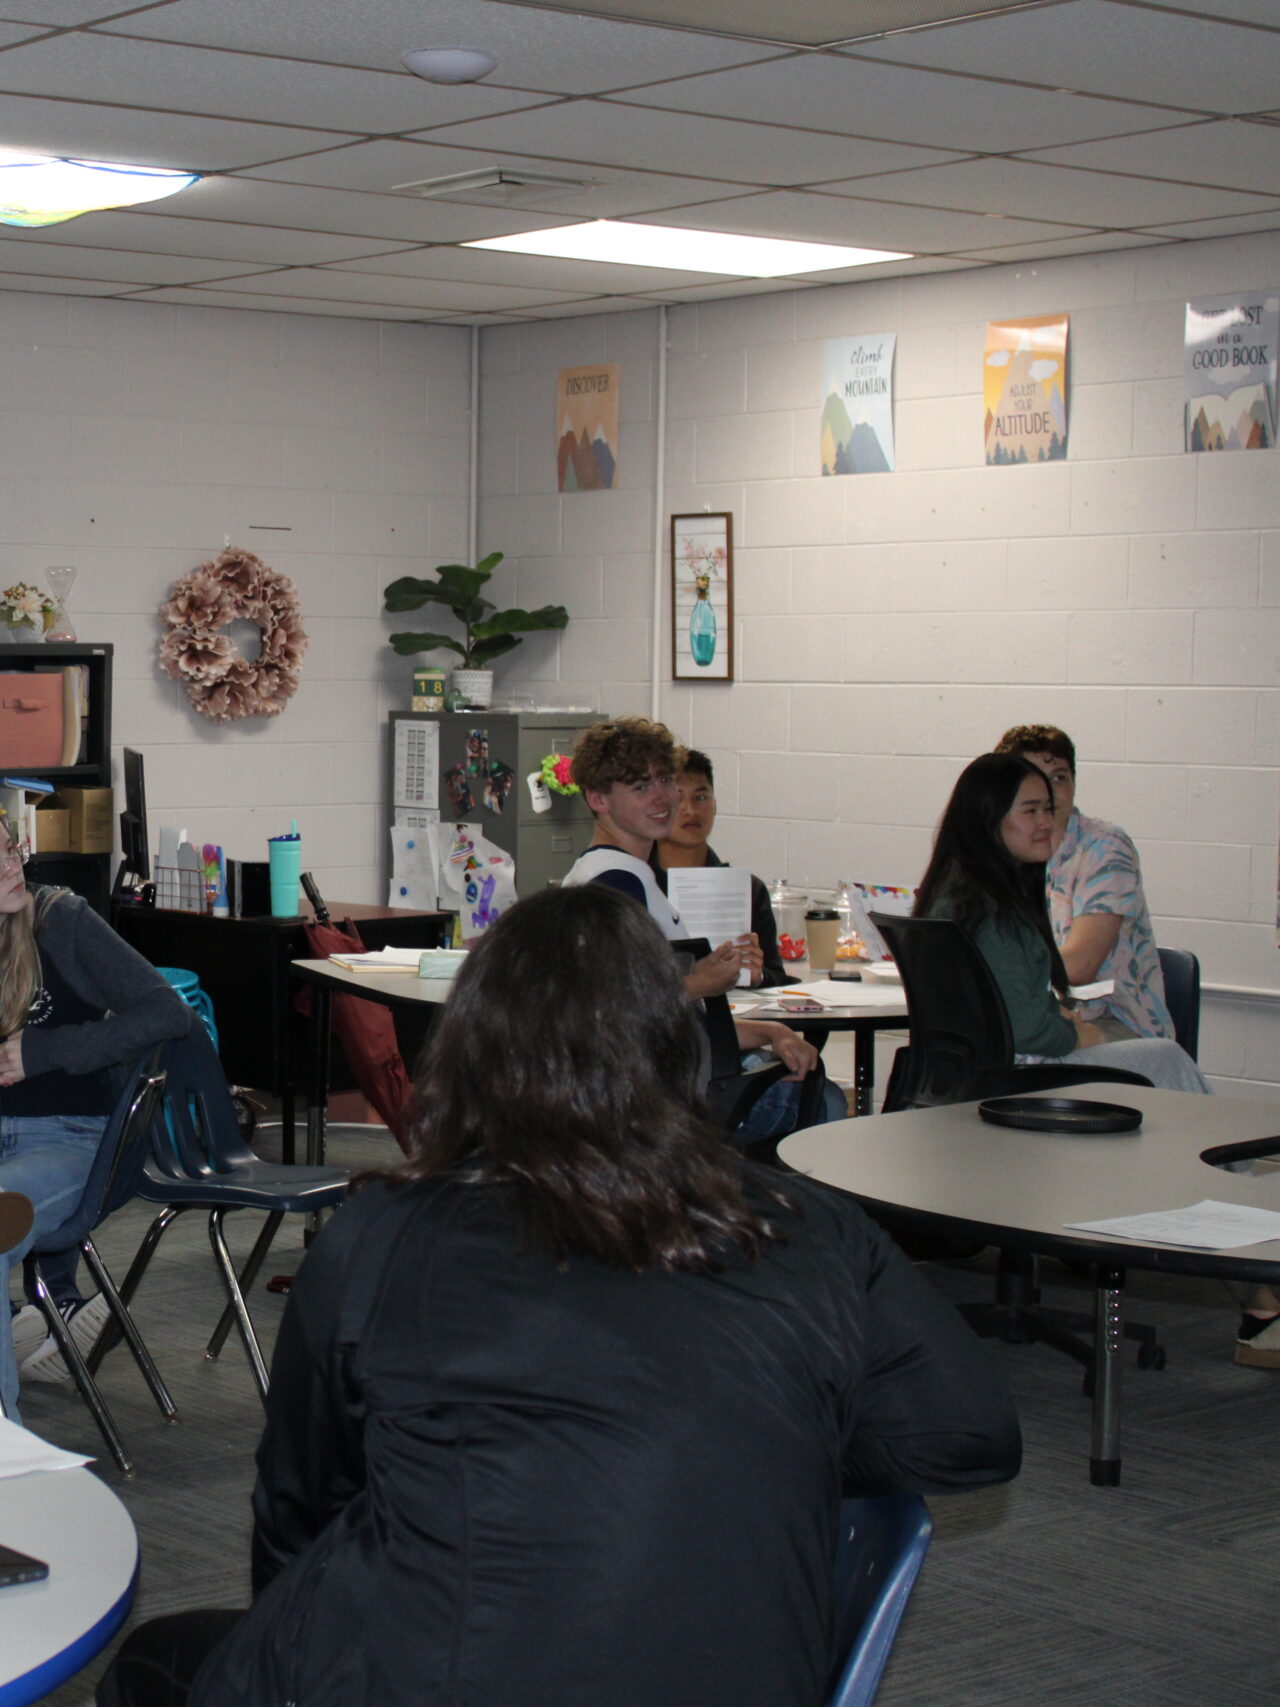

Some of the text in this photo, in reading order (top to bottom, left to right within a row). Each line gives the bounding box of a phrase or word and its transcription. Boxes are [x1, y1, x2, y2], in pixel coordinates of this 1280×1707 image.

[1229, 305, 1263, 327] OST
[1192, 346, 1268, 370] GOOD BOOK
[566, 374, 609, 396] DISCOVER
[845, 377, 887, 397] MOUNTAIN
[995, 412, 1050, 436] ALTITUDE
